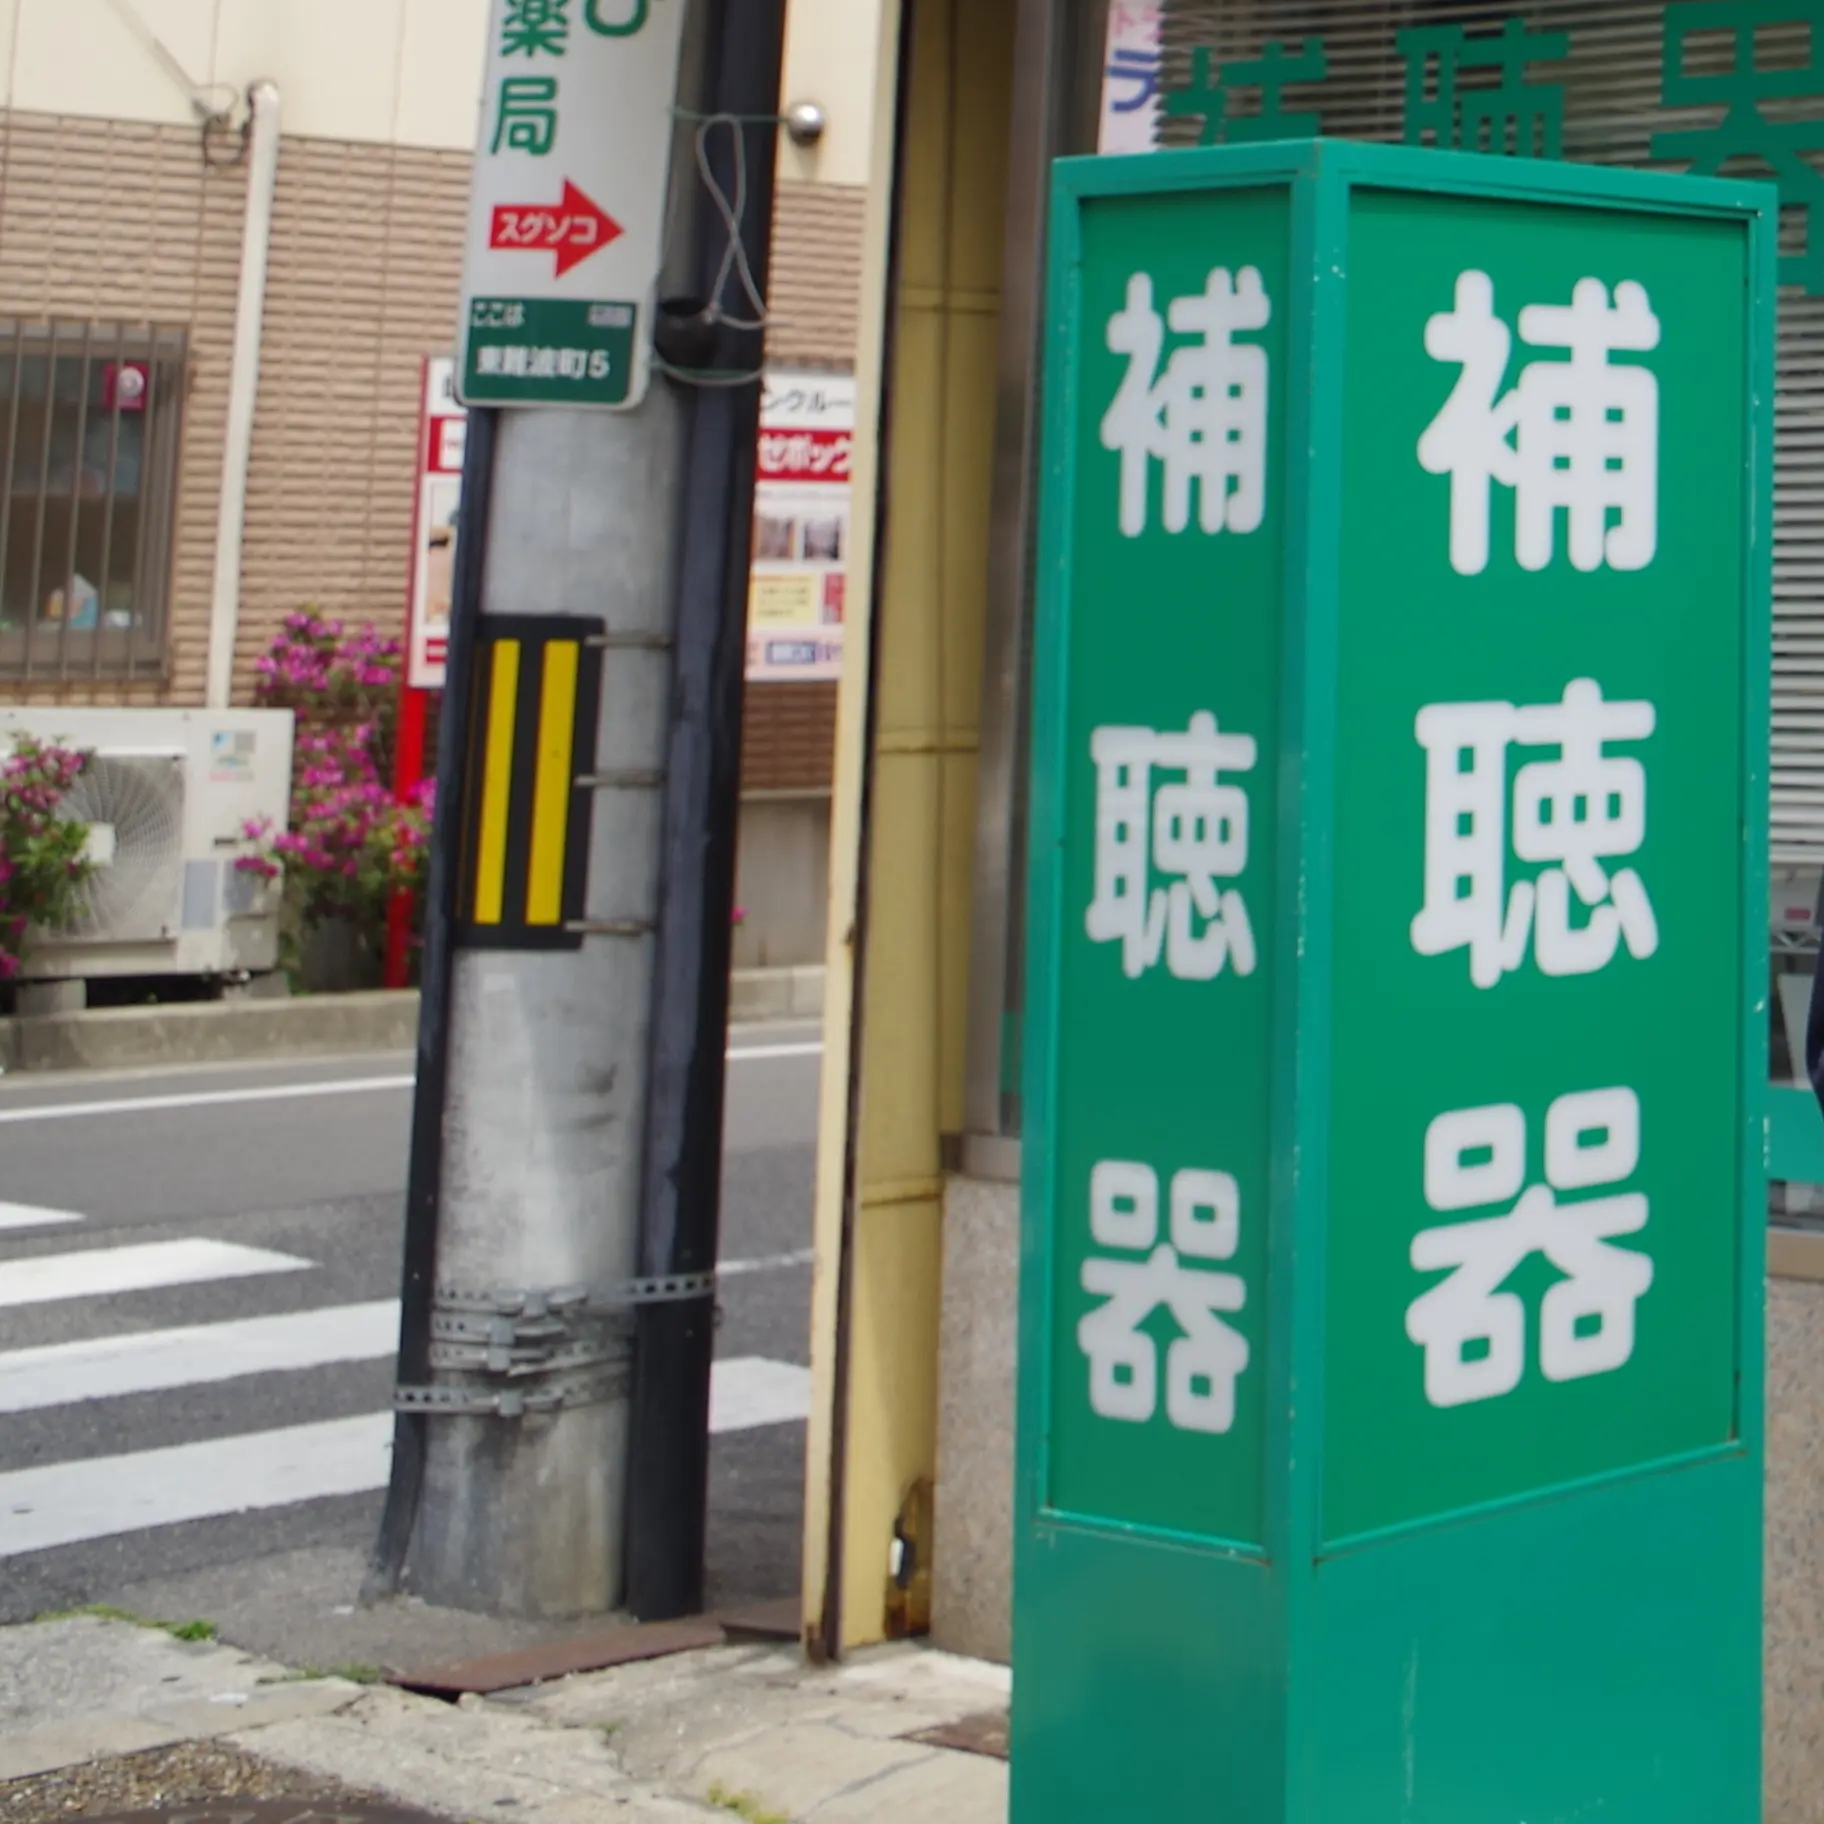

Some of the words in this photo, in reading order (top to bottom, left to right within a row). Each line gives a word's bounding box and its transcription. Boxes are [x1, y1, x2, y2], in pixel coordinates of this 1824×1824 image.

[496, 211, 599, 246] スグソコ
[1076, 264, 1272, 1436] 補聴器
[1403, 268, 1662, 1409] 補聴器
